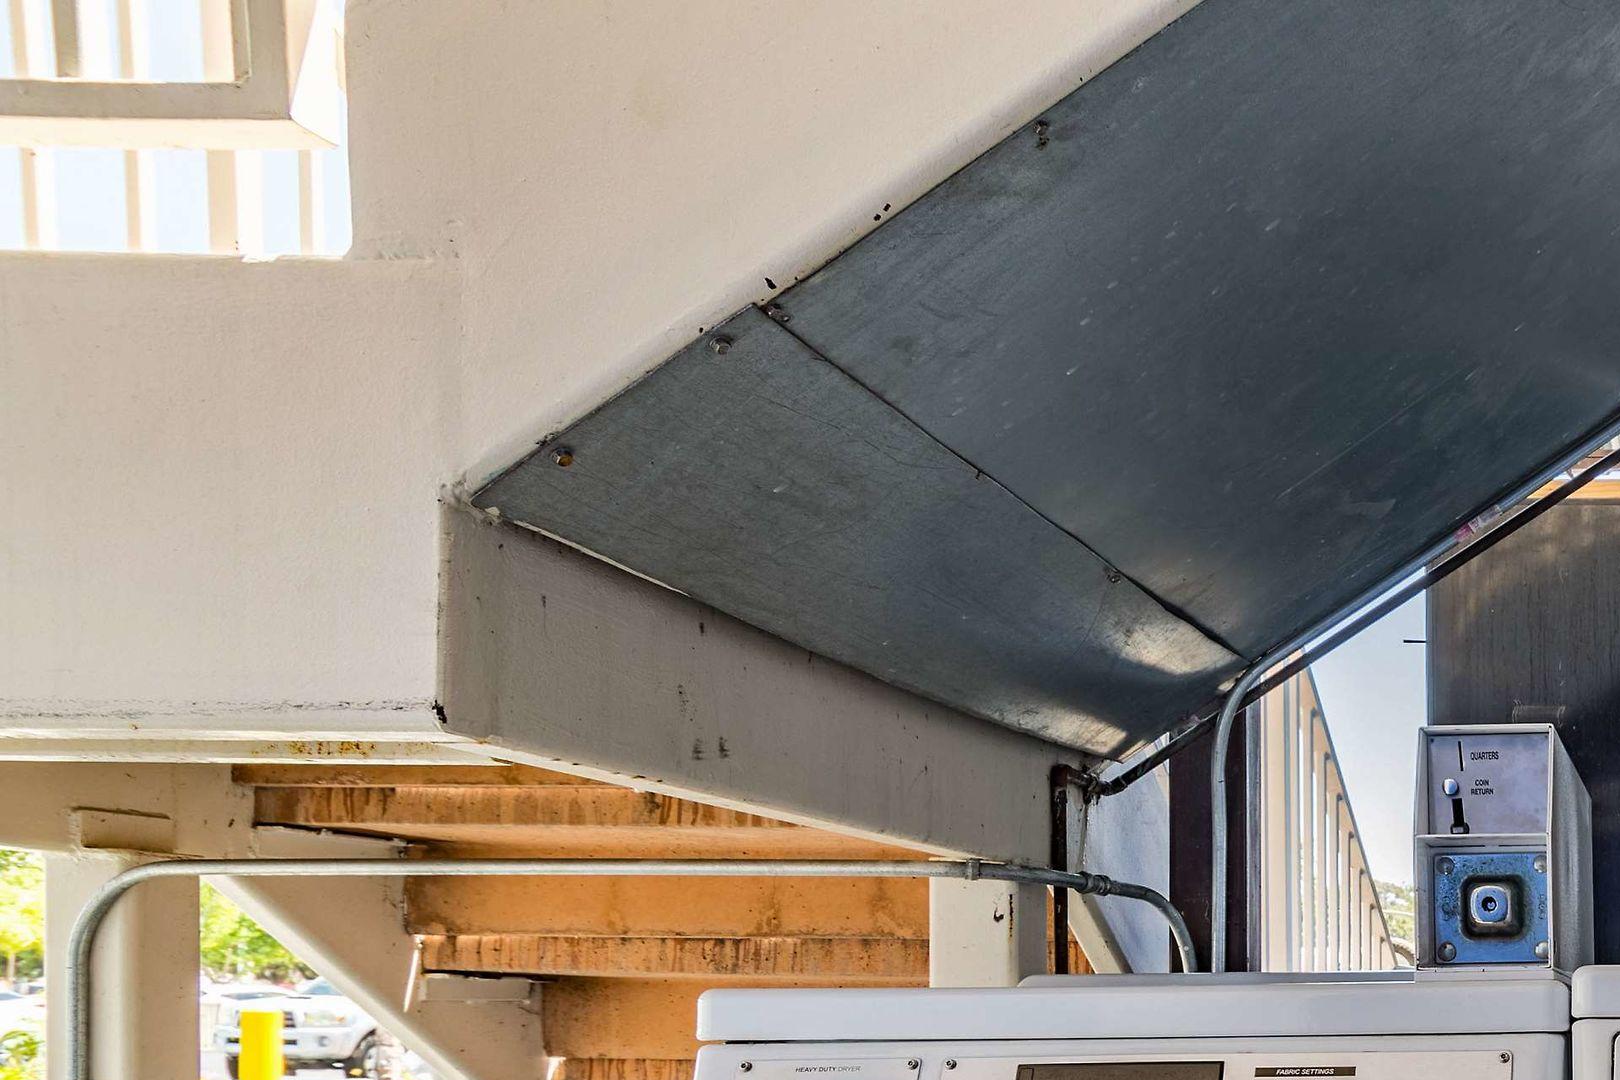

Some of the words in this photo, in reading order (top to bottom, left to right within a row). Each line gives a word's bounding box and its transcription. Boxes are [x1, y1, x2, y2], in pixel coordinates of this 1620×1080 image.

[1470, 751, 1499, 761] QUARTERS
[1474, 779, 1490, 787] COIN
[1470, 788, 1494, 796] RETURN
